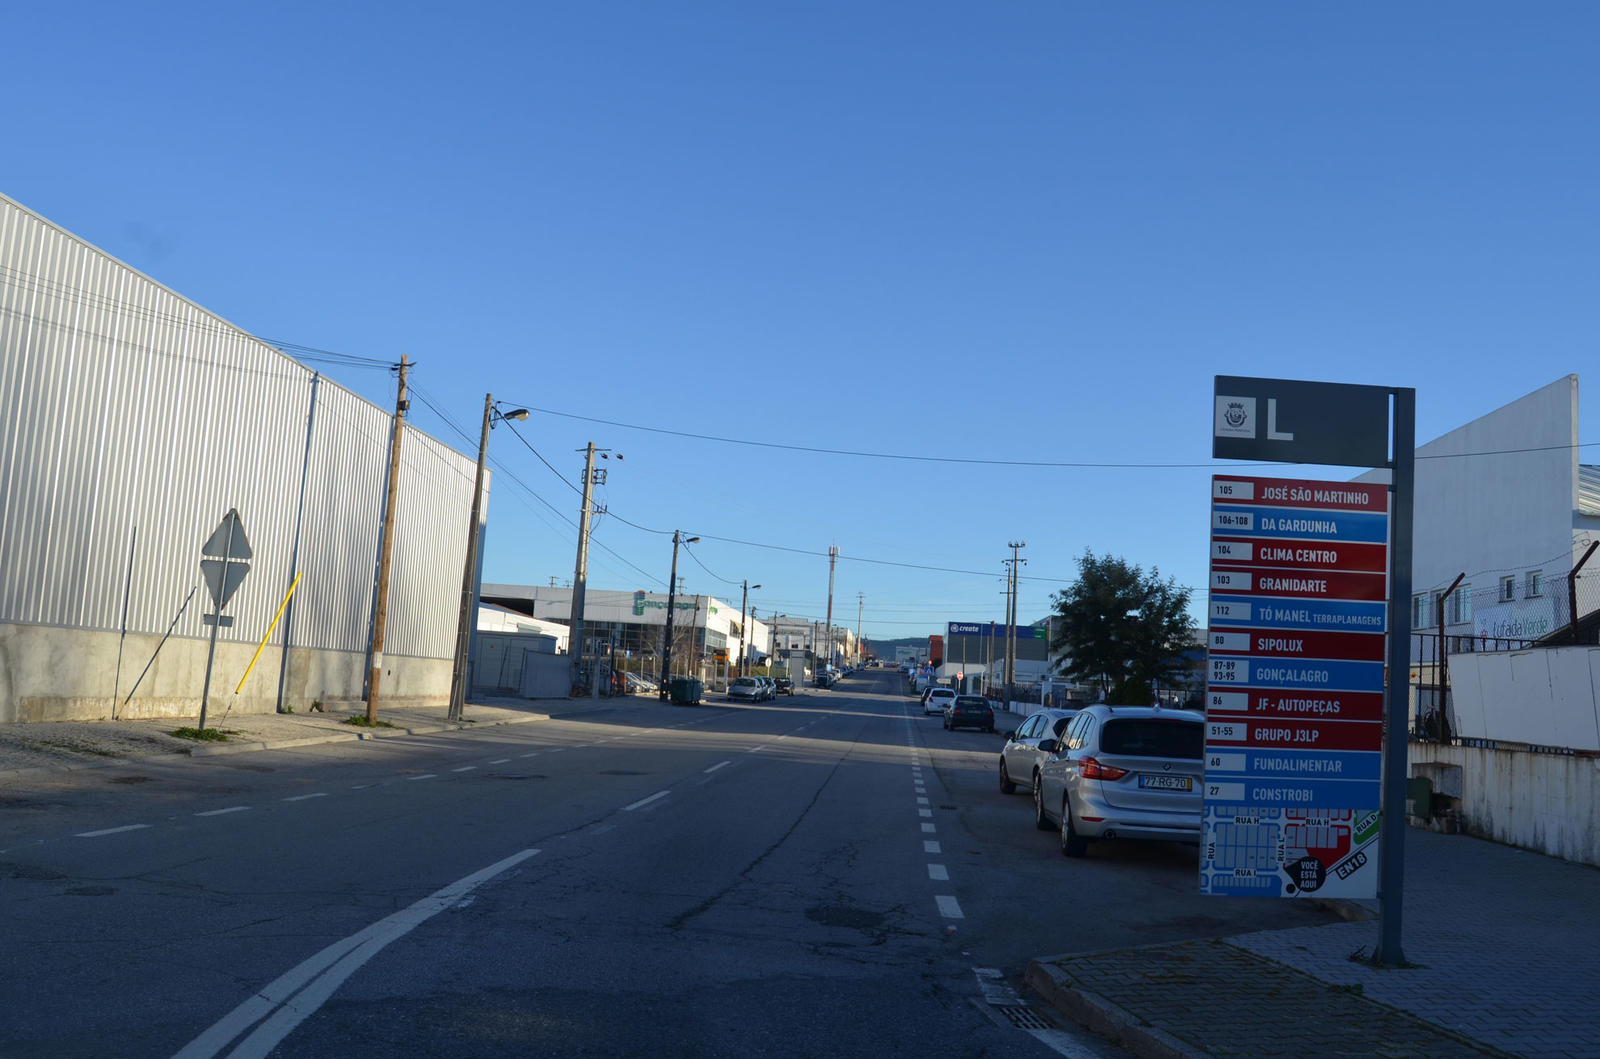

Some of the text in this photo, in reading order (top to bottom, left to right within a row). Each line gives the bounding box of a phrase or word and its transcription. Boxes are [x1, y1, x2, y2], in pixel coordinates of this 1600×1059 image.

[1267, 398, 1294, 441] L
[1220, 485, 1369, 505] 105 JOSÉ SÃO MARTINHO
[1218, 516, 1337, 534] 106-108 DA GARDUNHA
[1218, 545, 1337, 564] 104 CLIMA CENTRO
[1217, 575, 1327, 593] 103 GRANIDARTE
[1216, 606, 1382, 626] 112 TÓ MANEL TERRAPLANAGENS
[1258, 638, 1303, 652] SIPOLUX
[1214, 661, 1236, 671] 87-89
[1214, 672, 1235, 681] 93-95
[1256, 668, 1329, 684] GONÇALAGRO
[1212, 696, 1222, 706] 86
[1256, 698, 1268, 711] JF
[1278, 698, 1340, 716] AUTOPEÇAS
[1212, 726, 1319, 743] 51-55 GRUPO J3LP
[1210, 757, 1342, 773] 60 FUNDALIMENTAR
[1210, 786, 1313, 802] 27 CONSTROBI
[1235, 816, 1252, 824] RUA
[1306, 818, 1324, 826] RUA
[1356, 819, 1372, 833] RUA
[1208, 842, 1216, 860] RUA
[1300, 860, 1319, 870] VOCÊ
[1300, 870, 1317, 880] ESTÁ
[1300, 880, 1317, 888] AQUI
